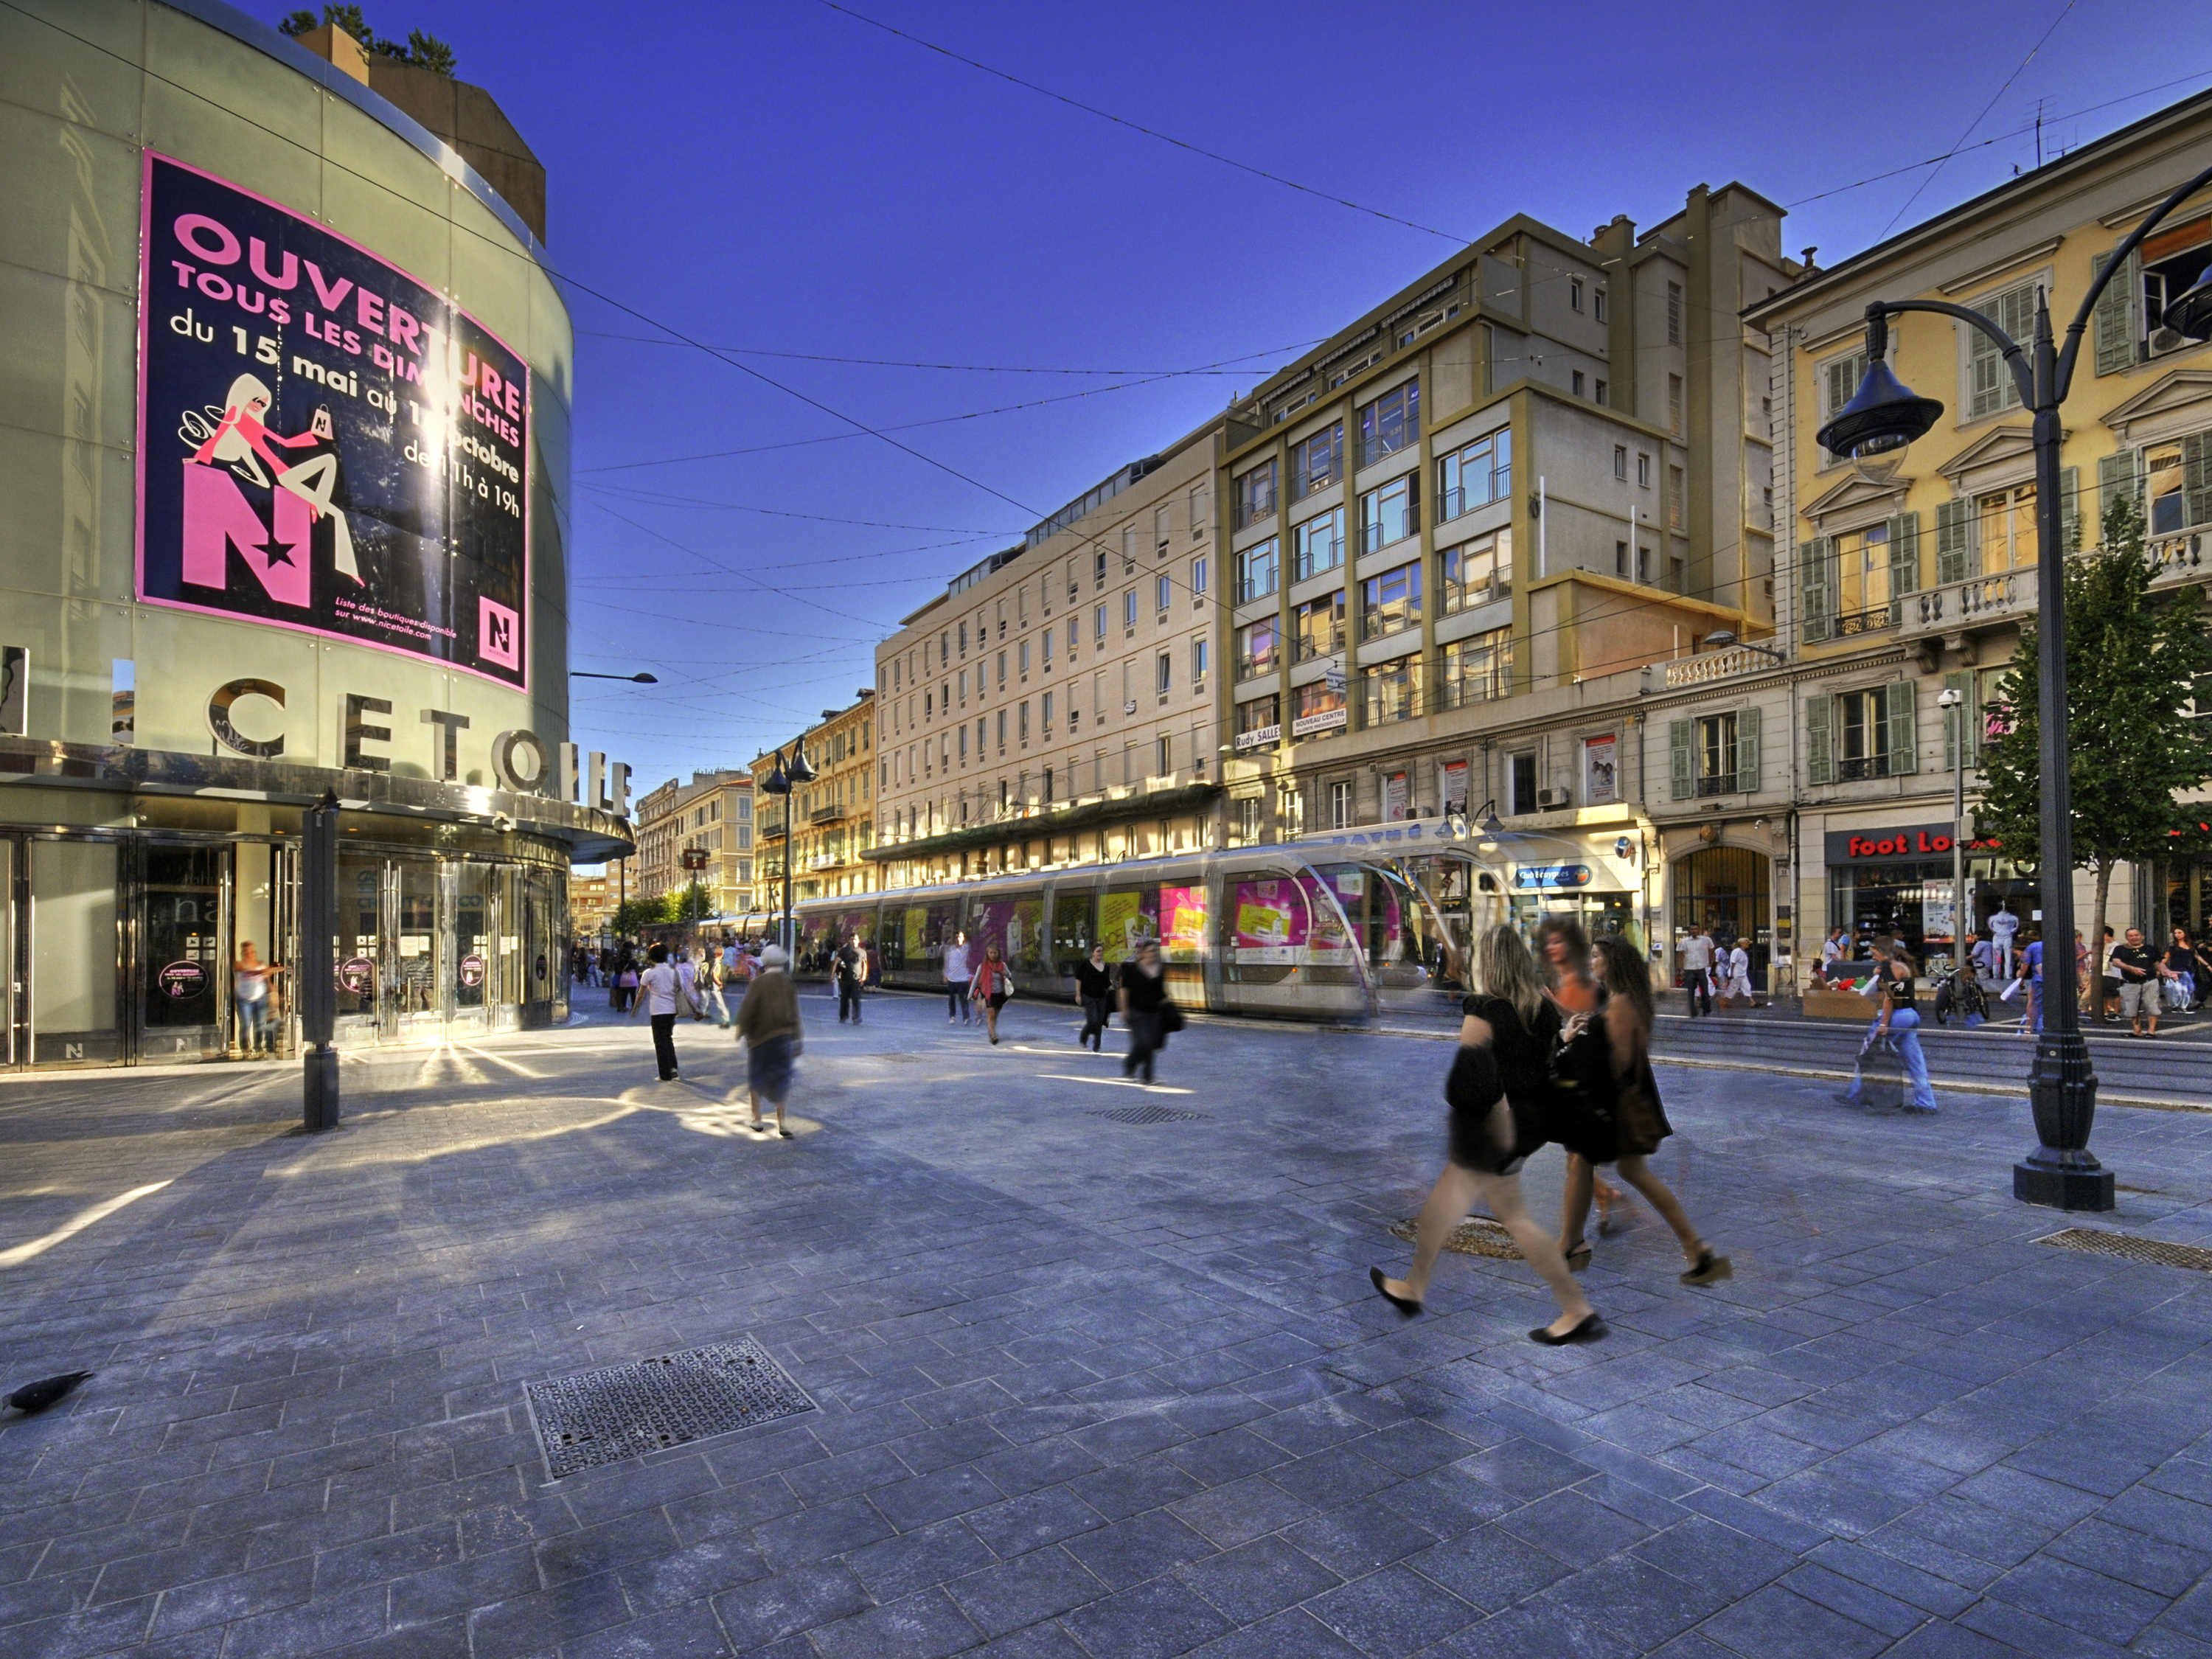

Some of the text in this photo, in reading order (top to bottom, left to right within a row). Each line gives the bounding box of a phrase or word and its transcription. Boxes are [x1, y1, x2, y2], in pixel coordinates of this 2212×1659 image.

[173, 213, 520, 422] OUVERTURE
[171, 260, 520, 448] TOUS LES DIMNCHES
[170, 307, 214, 343] du
[232, 325, 279, 365] 15
[293, 355, 358, 397] mai
[366, 389, 397, 417] au
[450, 429, 520, 484] octobre
[403, 439, 520, 518] de 11h à 19h
[335, 597, 458, 639] Liste des boutiques disponible
[335, 609, 432, 641] sur www.nicetoile.com
[1295, 709, 1346, 727] NOUVEAU CENTRE
[1236, 733, 1255, 748] Rudy
[1849, 834, 1908, 858] Foot
